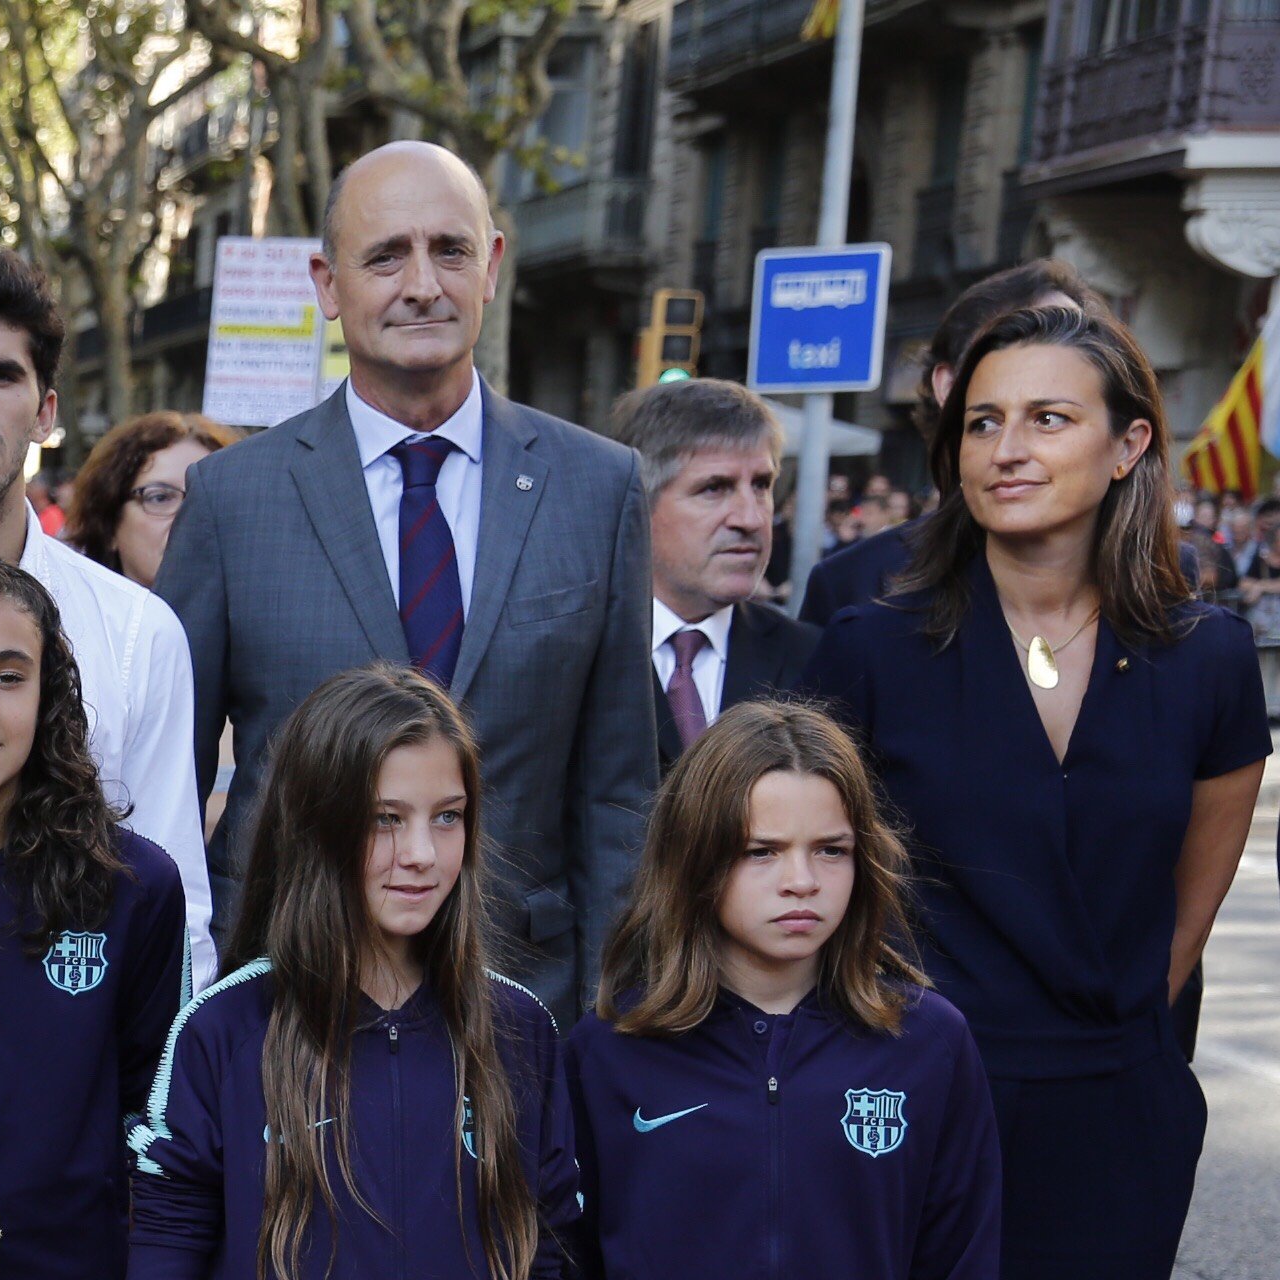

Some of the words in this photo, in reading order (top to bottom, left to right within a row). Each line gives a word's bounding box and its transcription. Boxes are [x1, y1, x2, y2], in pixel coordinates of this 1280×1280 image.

[788, 337, 841, 369] taxi
[64, 957, 87, 966] FCB
[862, 1117, 885, 1126] FCB
